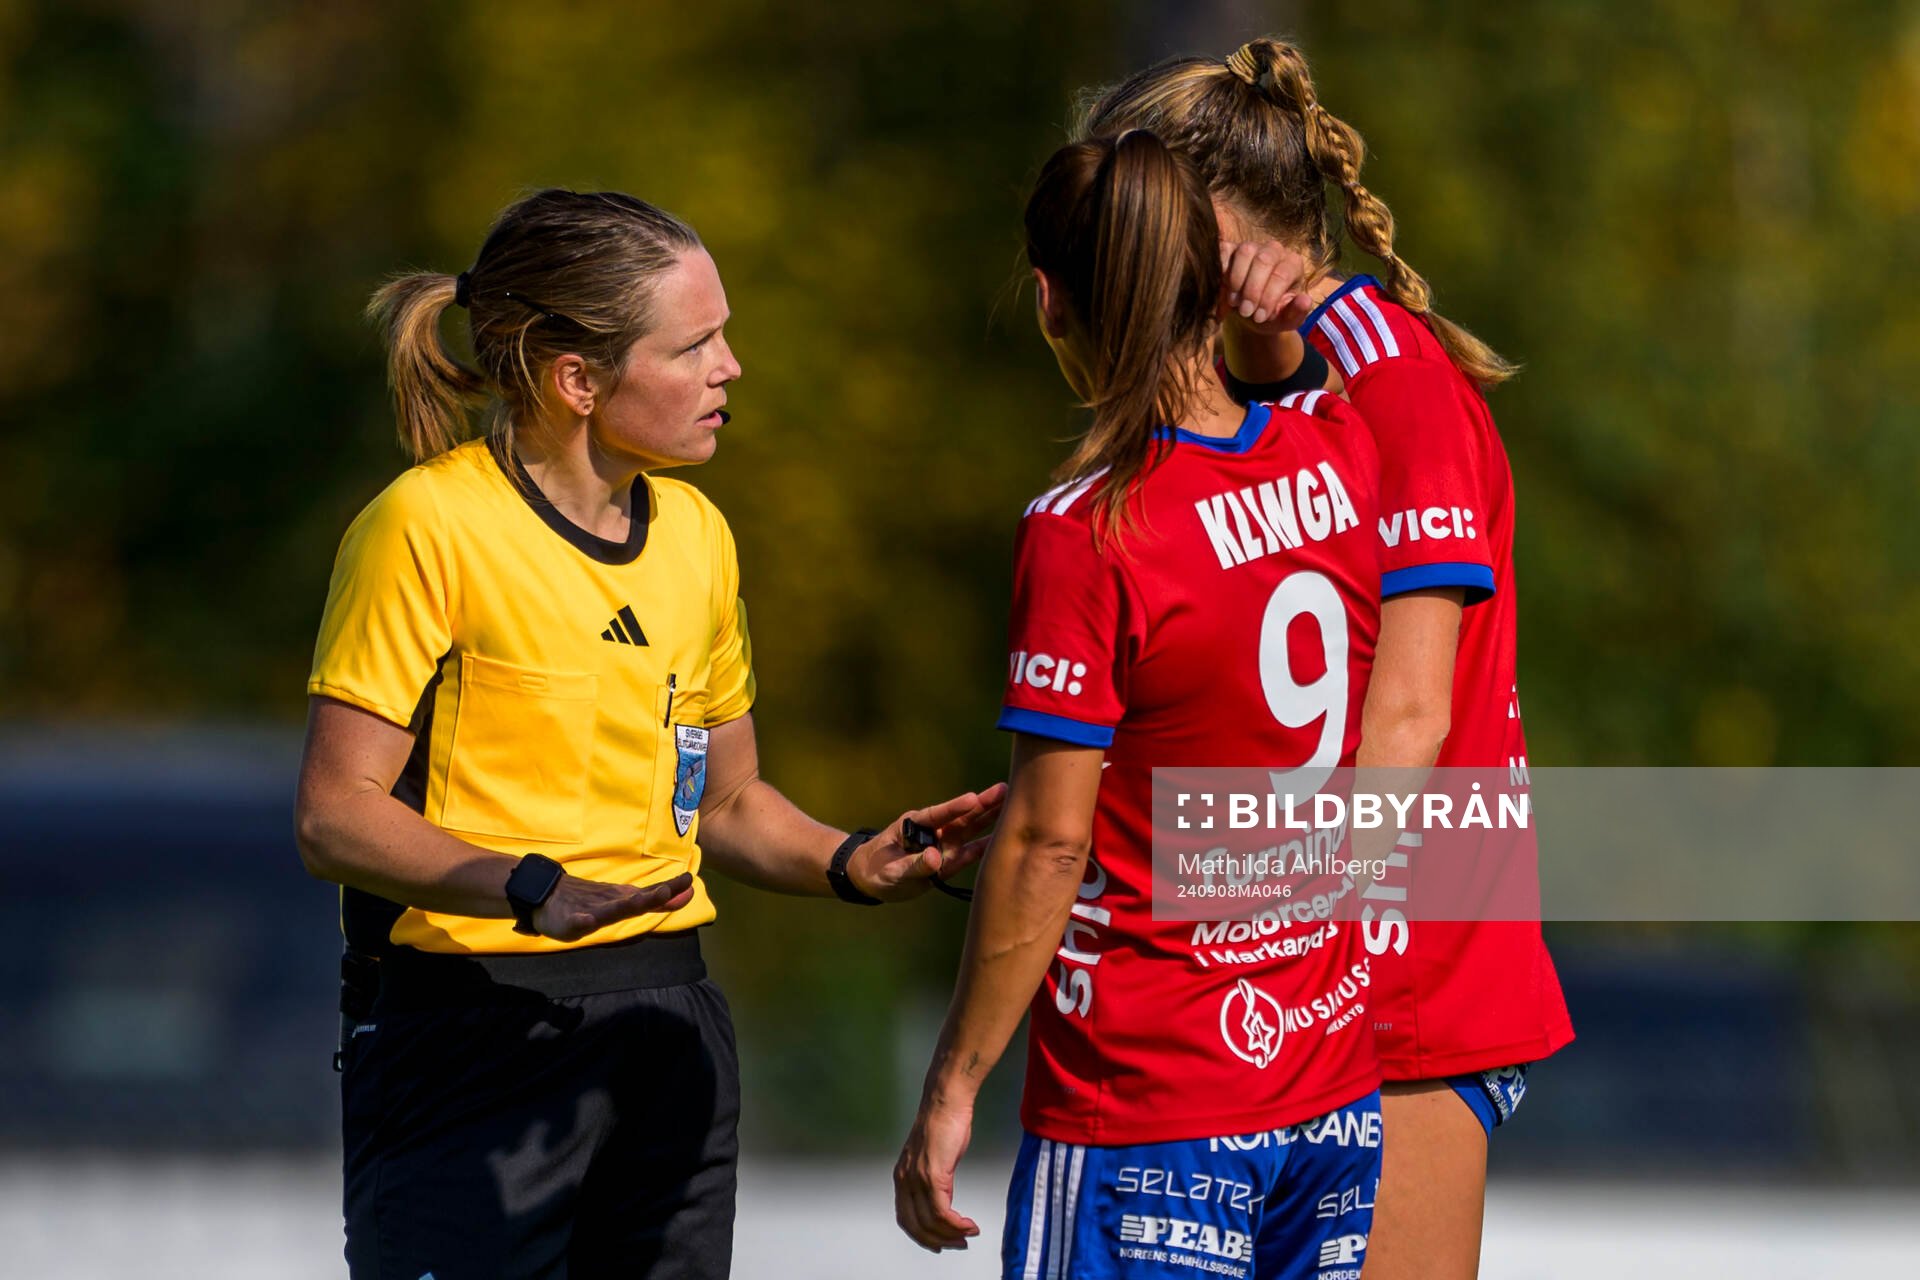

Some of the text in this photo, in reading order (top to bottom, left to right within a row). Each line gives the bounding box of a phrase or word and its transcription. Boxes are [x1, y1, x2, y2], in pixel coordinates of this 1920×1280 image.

[1194, 461, 1360, 570] KLINGA
[1377, 506, 1477, 548] VICI:
[1258, 570, 1350, 810] 9
[1137, 1215, 1246, 1261] PEAB
